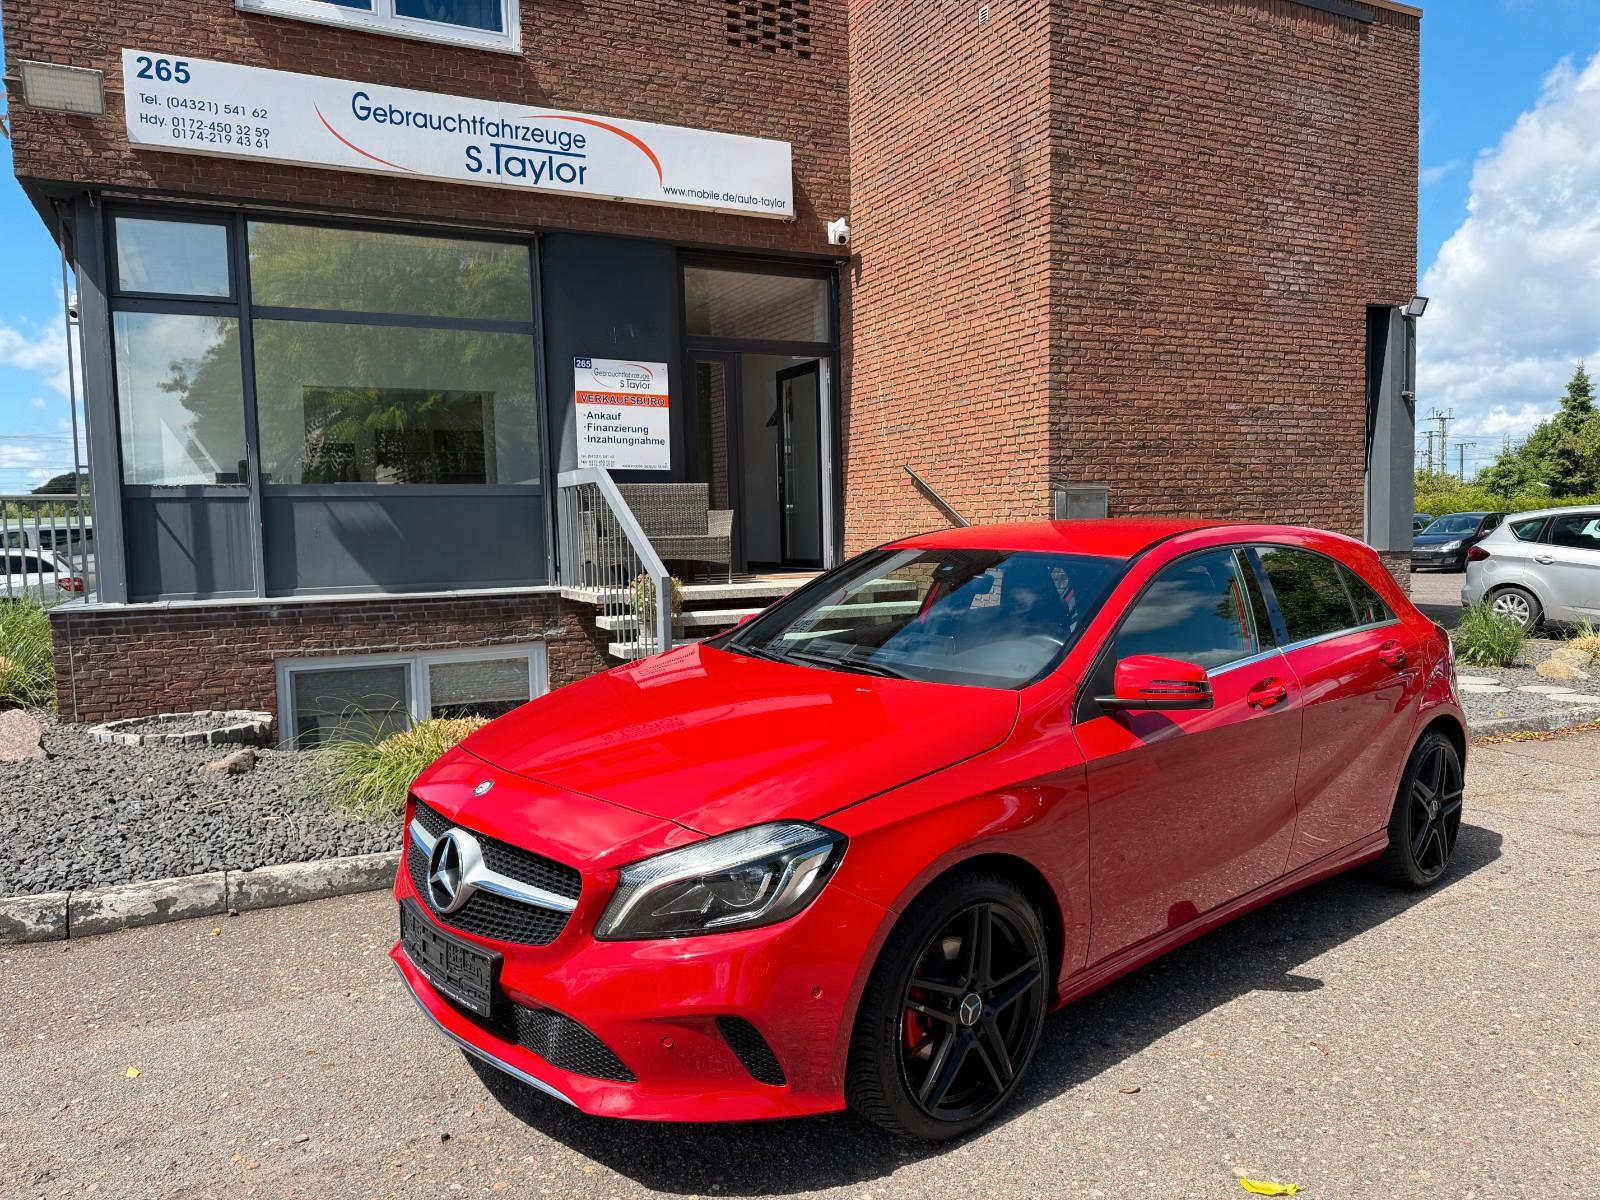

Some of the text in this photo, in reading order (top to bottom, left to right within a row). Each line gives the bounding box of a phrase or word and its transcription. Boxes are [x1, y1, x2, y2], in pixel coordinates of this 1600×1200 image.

[136, 56, 191, 84] 265
[139, 93, 268, 119] Tel. (04321) 541 62
[139, 113, 270, 138] Hdy. 0172-450 32 59
[351, 91, 586, 151] Gebrauchtfahrzeuge
[172, 128, 269, 149] 0174-219 43 61
[465, 143, 587, 185] S.Taylor
[662, 186, 786, 209] www.mobile.de/auto-taylor
[576, 360, 591, 368] 265
[581, 394, 665, 407] VERKAUFSBÜRO
[586, 411, 621, 421] Ankauf
[587, 423, 649, 435] Finanzierung
[587, 435, 666, 446] Inzahlungnahme
